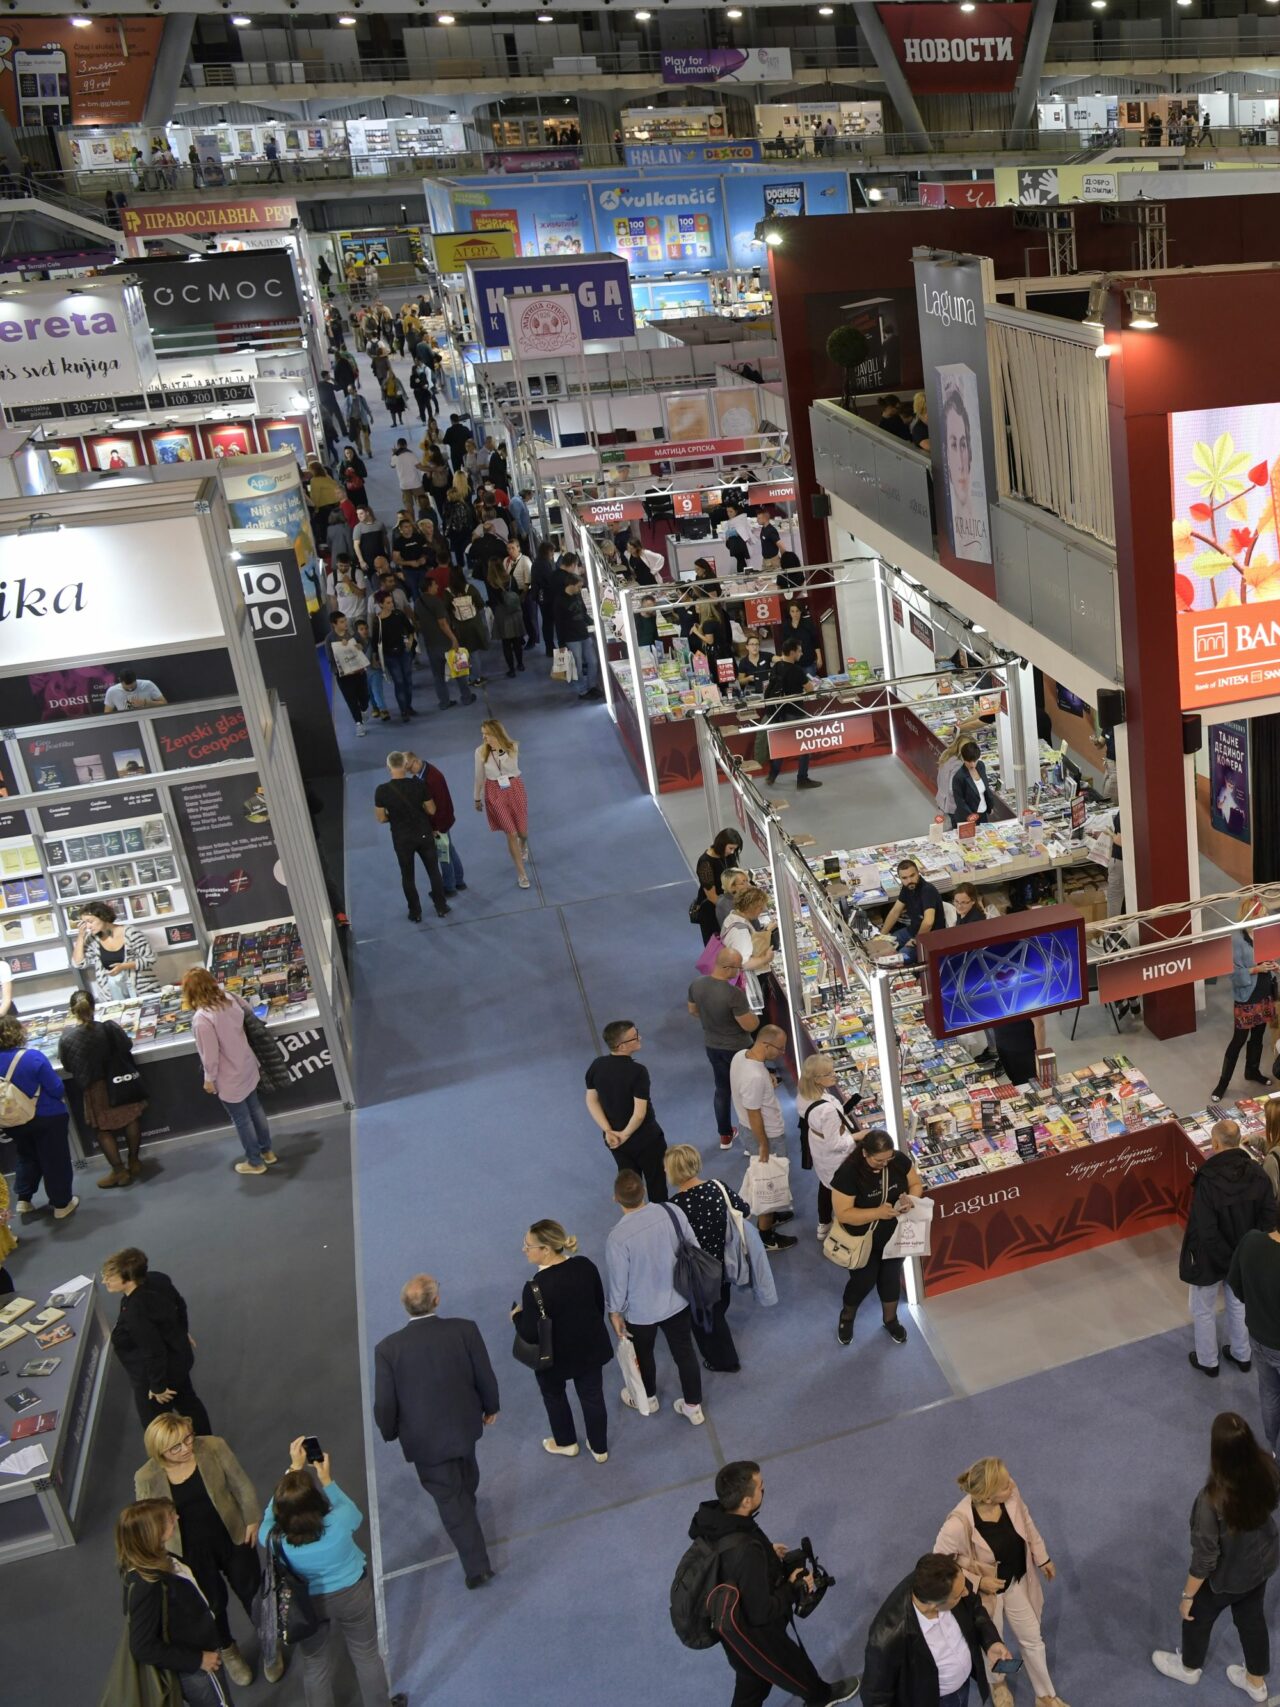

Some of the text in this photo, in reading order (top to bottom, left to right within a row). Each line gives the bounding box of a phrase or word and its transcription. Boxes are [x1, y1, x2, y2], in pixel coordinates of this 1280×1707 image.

[904, 36, 1013, 63] НОВОСТИ
[664, 55, 703, 68] Play for
[674, 63, 721, 76] Humanity
[630, 147, 683, 166] HALA IV
[1085, 178, 1110, 186] ДОБРО
[621, 187, 716, 208] vulkančić
[145, 204, 293, 229] ПРАВОСЛАВНА РЕЧ
[629, 221, 644, 229] 100
[679, 217, 694, 226] 100
[153, 279, 283, 306] ОСМОС
[923, 283, 977, 327] Laguna
[23, 356, 120, 378] svet knjiga
[654, 443, 716, 457] МАТИЦА СРПСКА
[768, 486, 794, 497] HITOVI
[250, 501, 287, 517] Nije sve
[591, 503, 624, 515] DOMAĆI
[682, 499, 692, 512] 9
[593, 512, 624, 522] AUTORI
[954, 516, 988, 540] KRALJICA
[757, 603, 770, 619] 8
[1218, 674, 1249, 688] INTESA
[49, 695, 89, 709] DORSI
[161, 724, 212, 754] Ženski
[795, 720, 845, 740] DOMAĆI
[1218, 730, 1239, 748] ТАЈНЕ
[800, 733, 843, 753] AUTORI
[1214, 741, 1245, 762] ДЕДИНОГ
[1216, 754, 1243, 774] КОФЕРА
[1142, 957, 1193, 981] HITOVI
[1066, 1160, 1107, 1181] Knjige
[1117, 1145, 1158, 1168] kojima
[1124, 1152, 1162, 1176] priča
[939, 1184, 1021, 1219] Laguna
